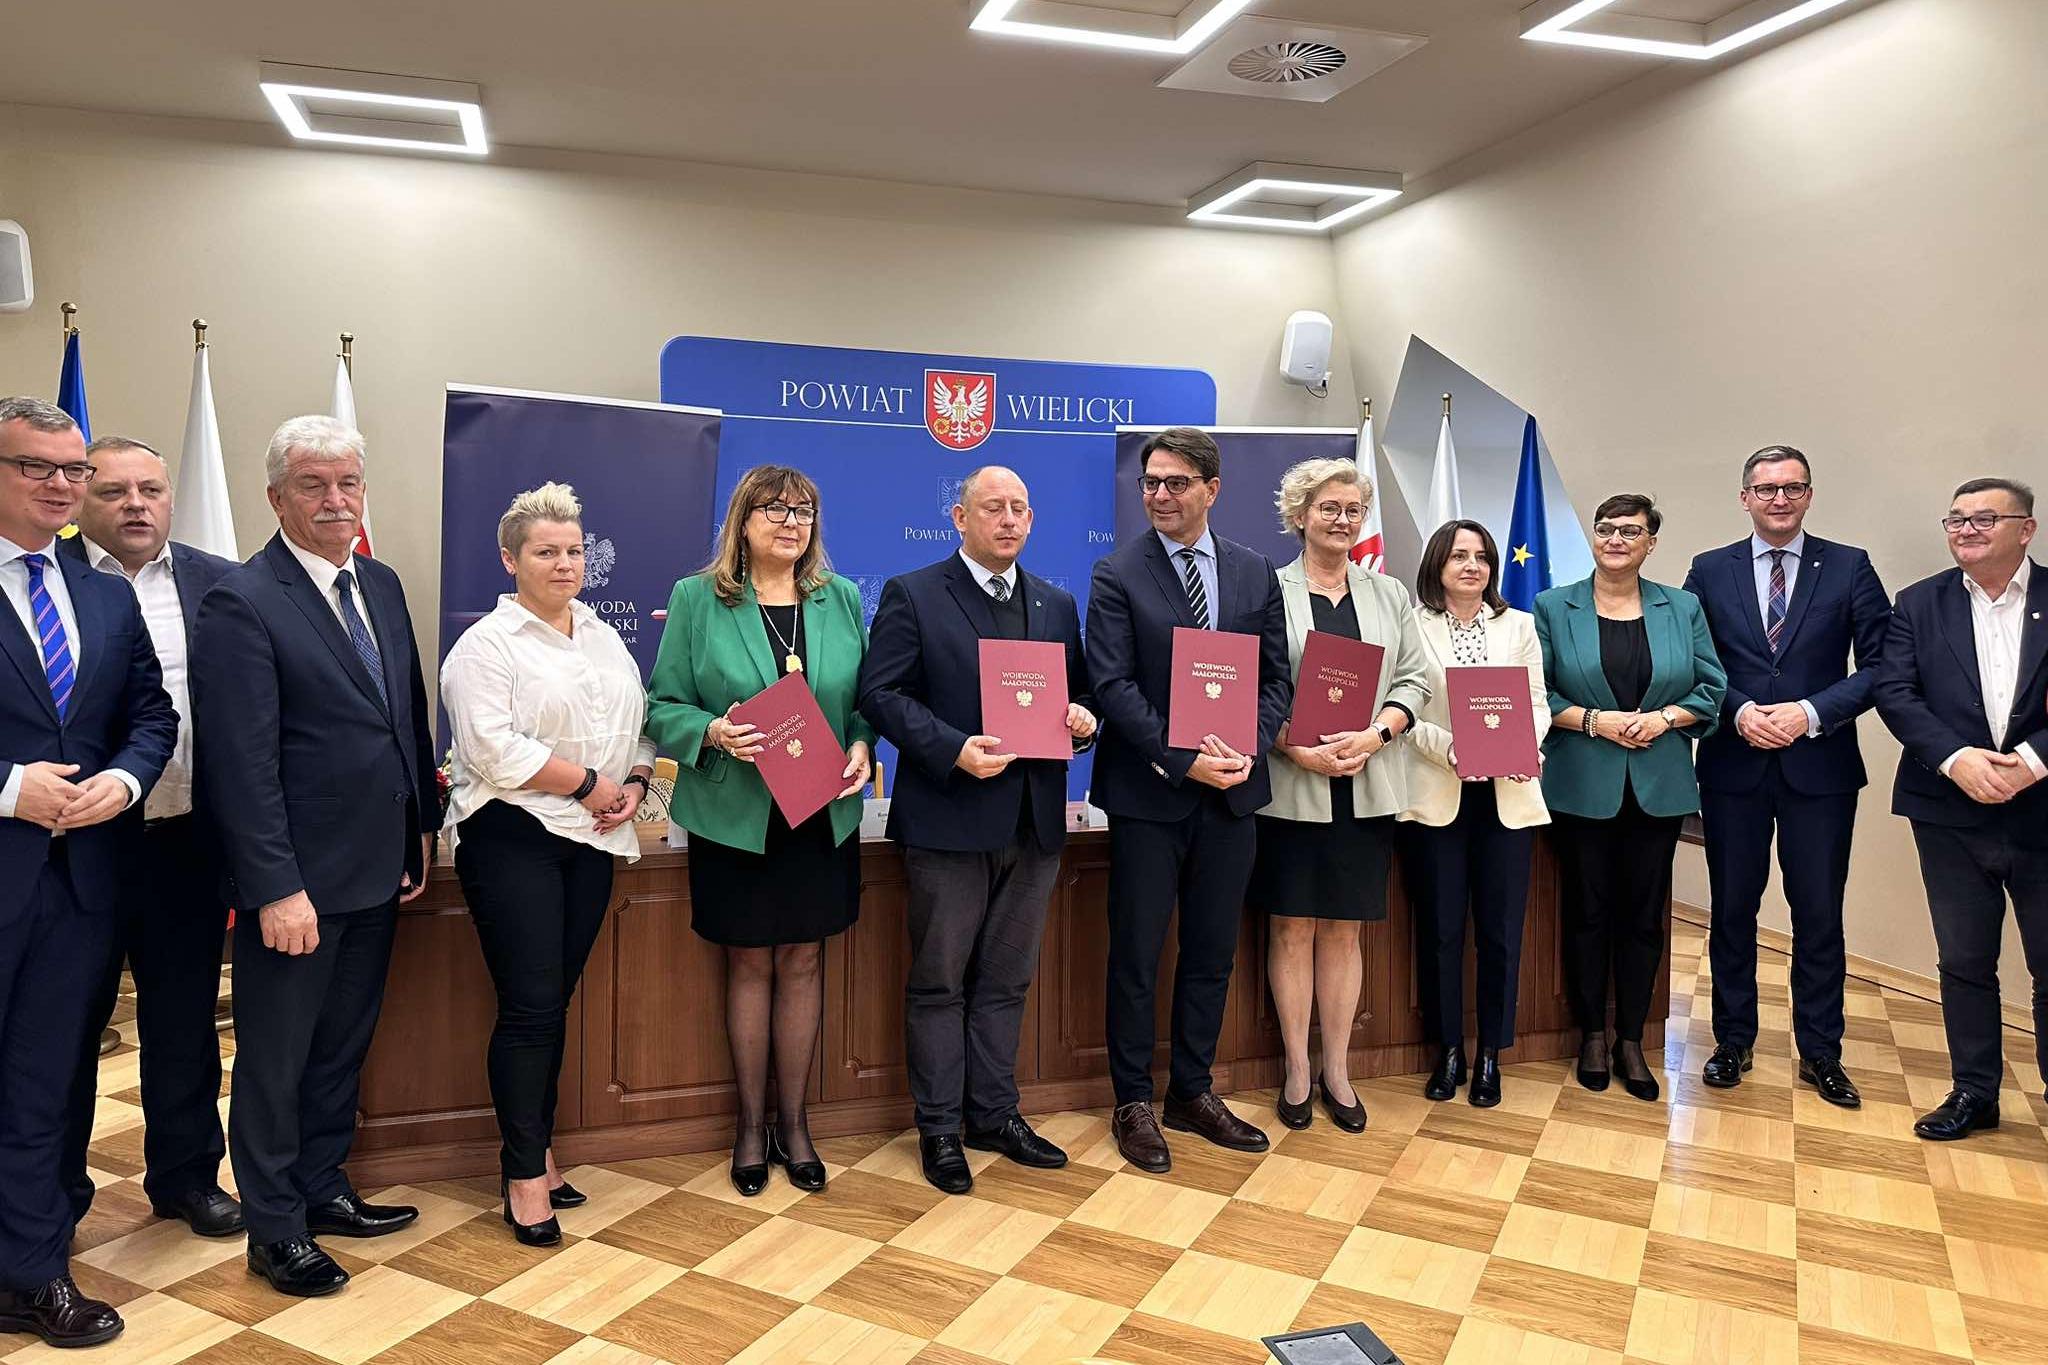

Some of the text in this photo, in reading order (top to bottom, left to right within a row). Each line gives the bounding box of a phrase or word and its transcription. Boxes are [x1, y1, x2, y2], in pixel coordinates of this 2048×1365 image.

[780, 380, 1135, 424] POWIAT WIELICKI
[904, 526, 954, 541] POWIAT
[1193, 661, 1236, 673] WOJEWODA
[1320, 665, 1359, 680] WOJEWODA
[1001, 671, 1046, 681] WOJEWODA
[1469, 696, 1511, 704] WOJEWODA
[766, 713, 801, 740] WOJEWODA
